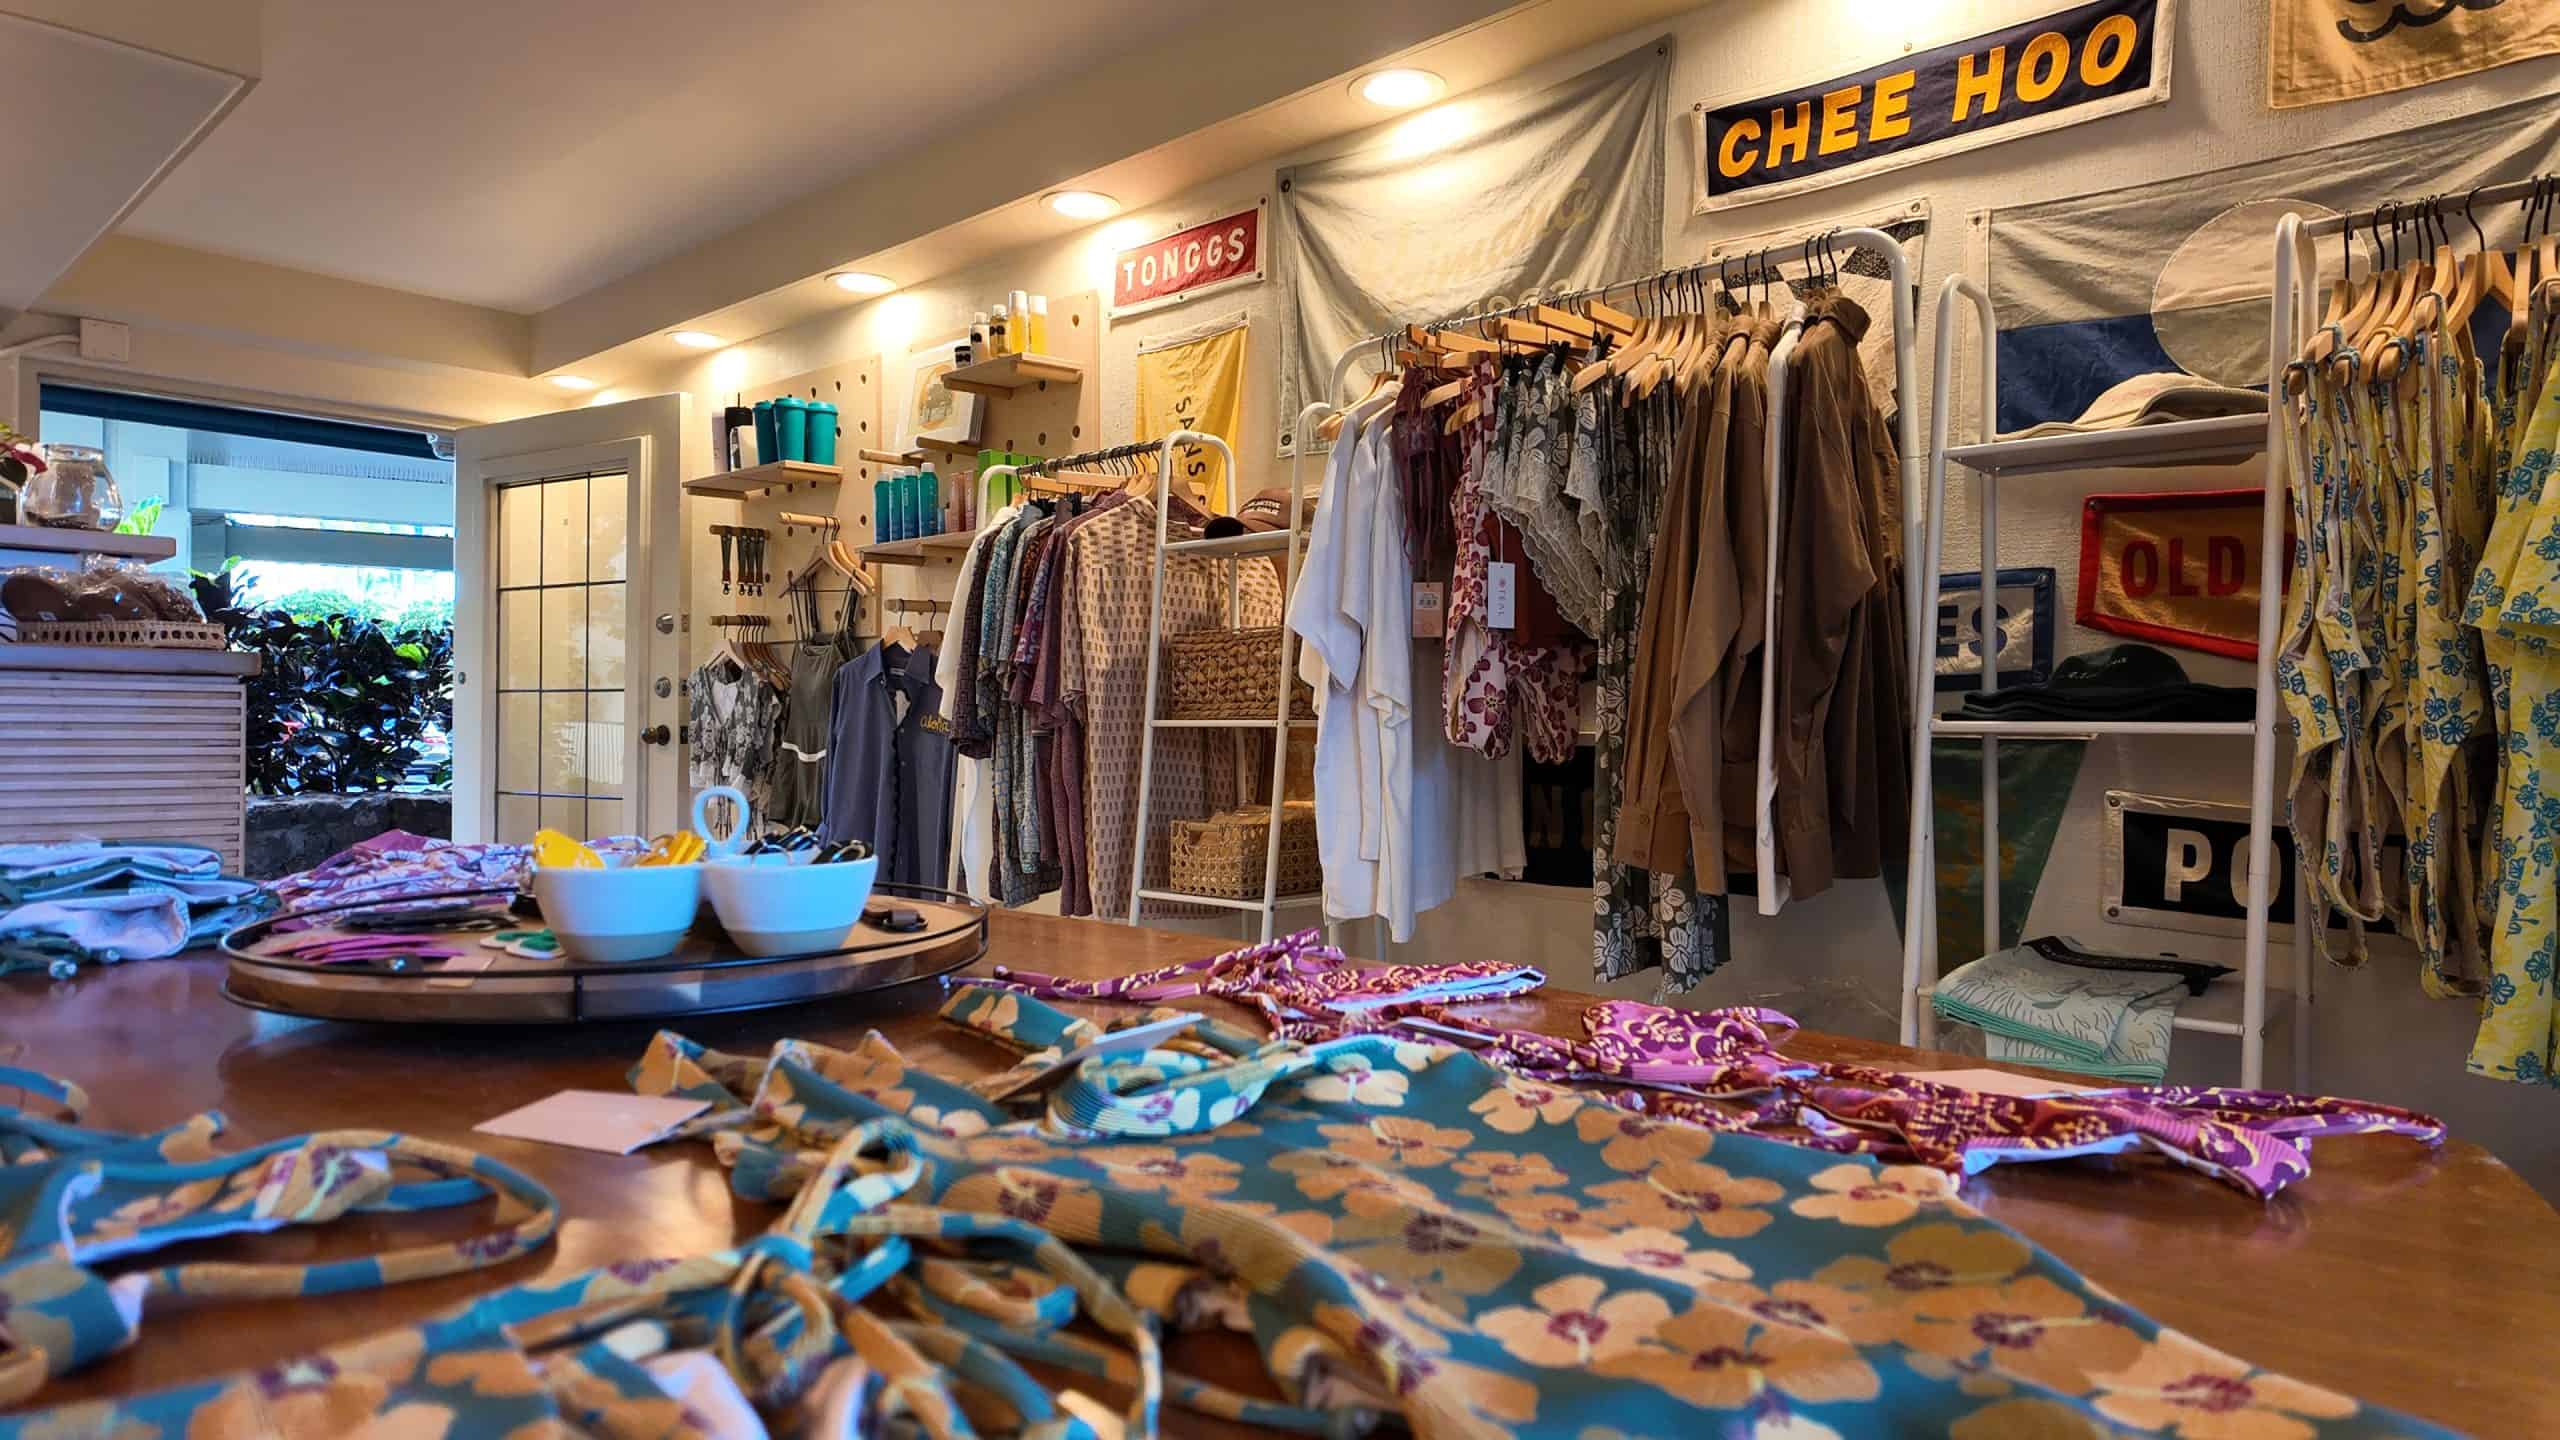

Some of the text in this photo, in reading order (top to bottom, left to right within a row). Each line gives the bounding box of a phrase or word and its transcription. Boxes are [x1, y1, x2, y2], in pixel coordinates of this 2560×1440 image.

[1717, 14, 2138, 179] CHEE HOO
[1122, 226, 1247, 293] TONGGS
[2120, 535, 2246, 599] OLD
